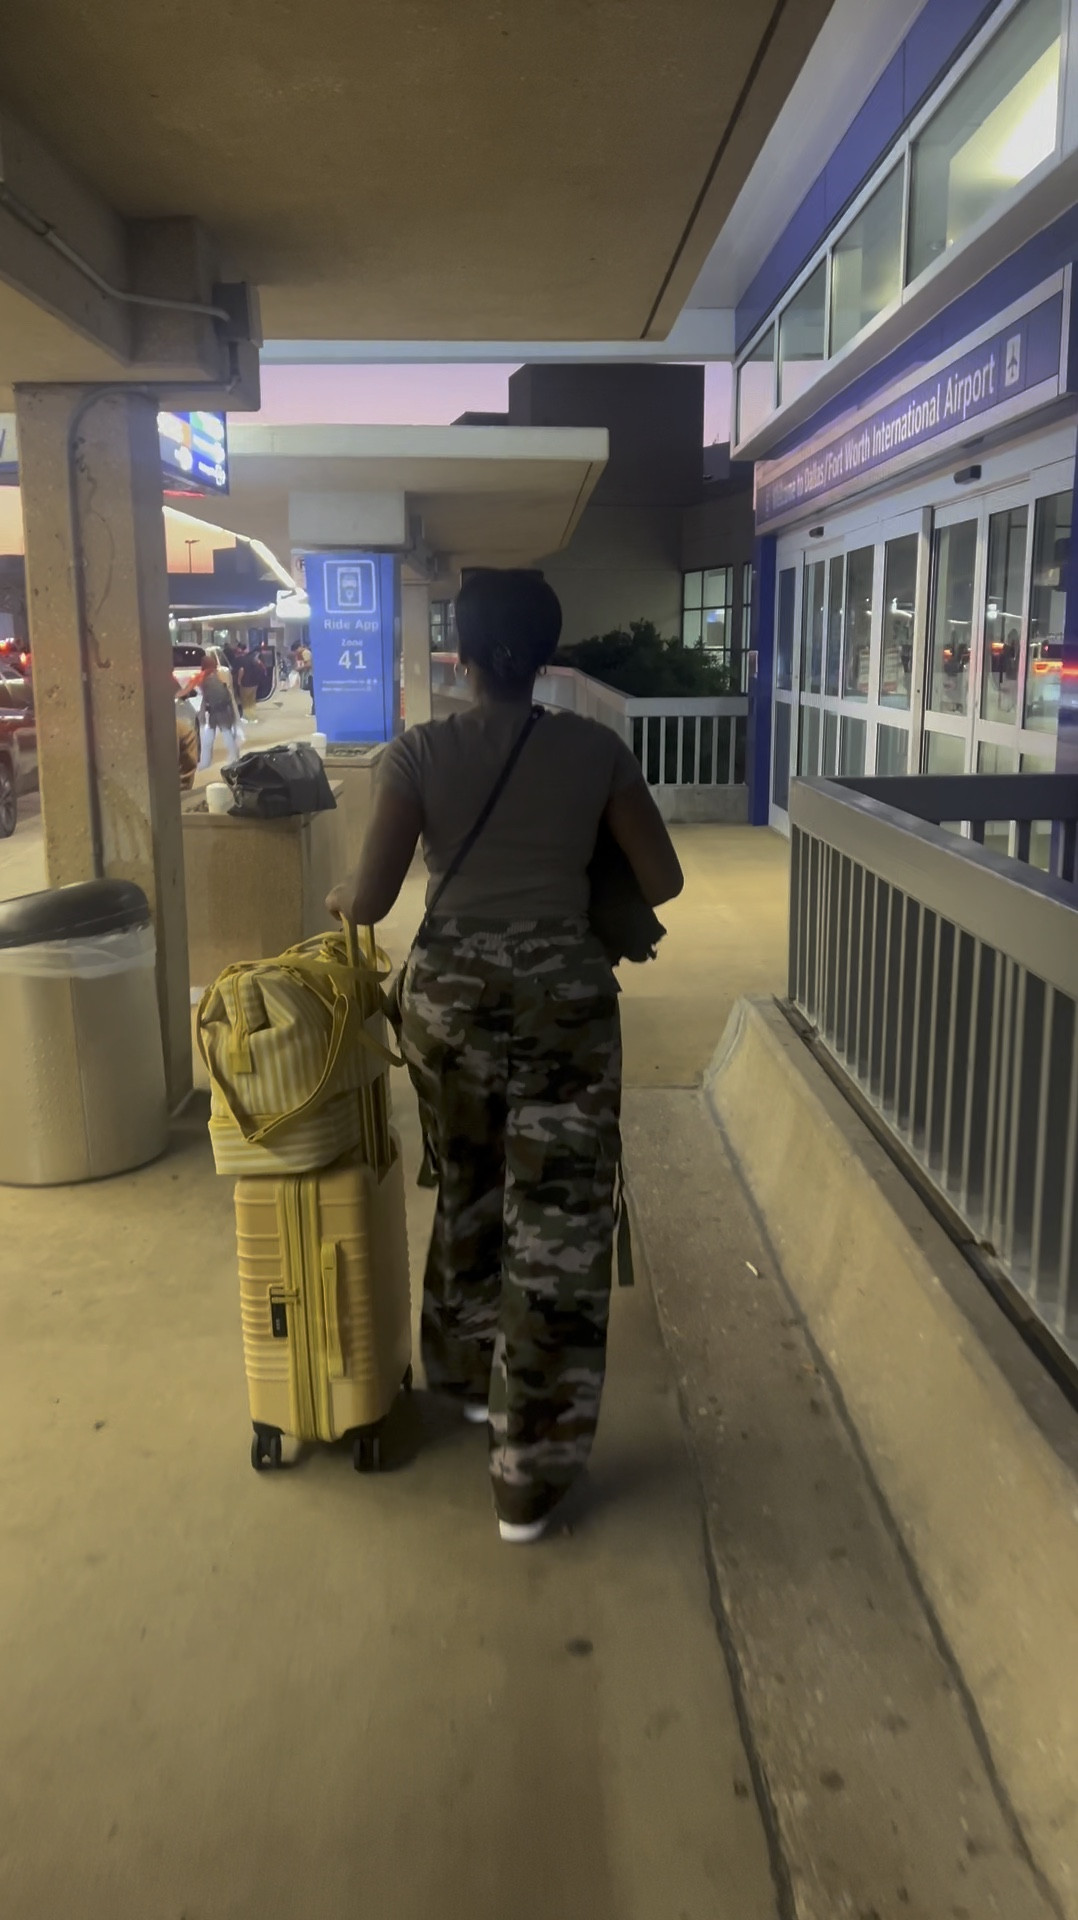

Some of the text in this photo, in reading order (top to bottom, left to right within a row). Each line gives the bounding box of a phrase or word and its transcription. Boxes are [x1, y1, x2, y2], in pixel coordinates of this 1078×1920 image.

[845, 429, 870, 471] Worth
[872, 384, 941, 457] International
[943, 354, 996, 420] Airport
[324, 618, 379, 632] Ride App
[341, 638, 363, 647] Zone
[338, 649, 367, 669] 41
